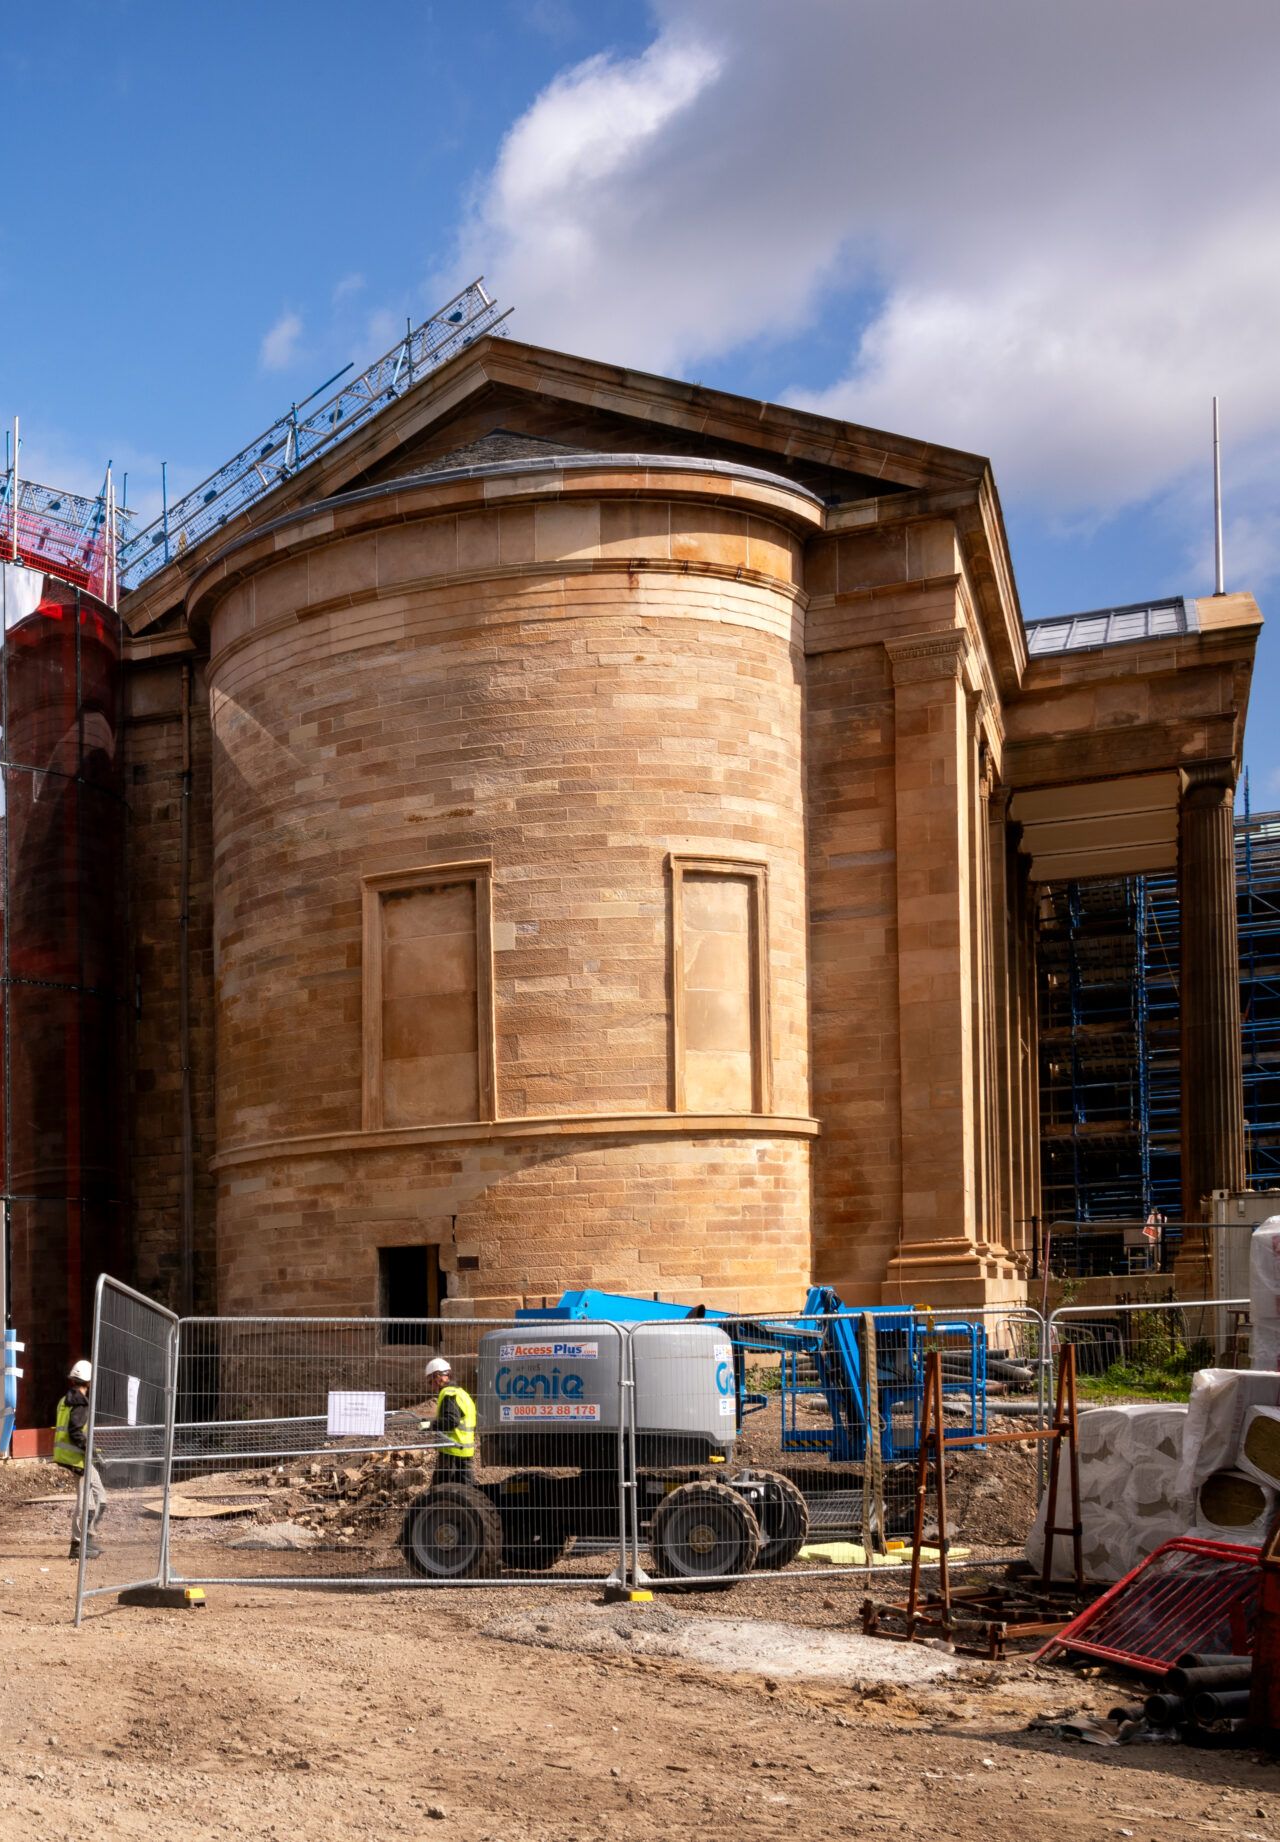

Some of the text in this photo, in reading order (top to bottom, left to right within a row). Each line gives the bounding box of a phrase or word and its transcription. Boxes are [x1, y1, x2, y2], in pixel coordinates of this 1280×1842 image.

[515, 1345, 552, 1356] Access
[553, 1343, 582, 1355] Plus
[495, 1366, 584, 1401] Genie
[513, 1405, 596, 1416] 0800 32 88 178
